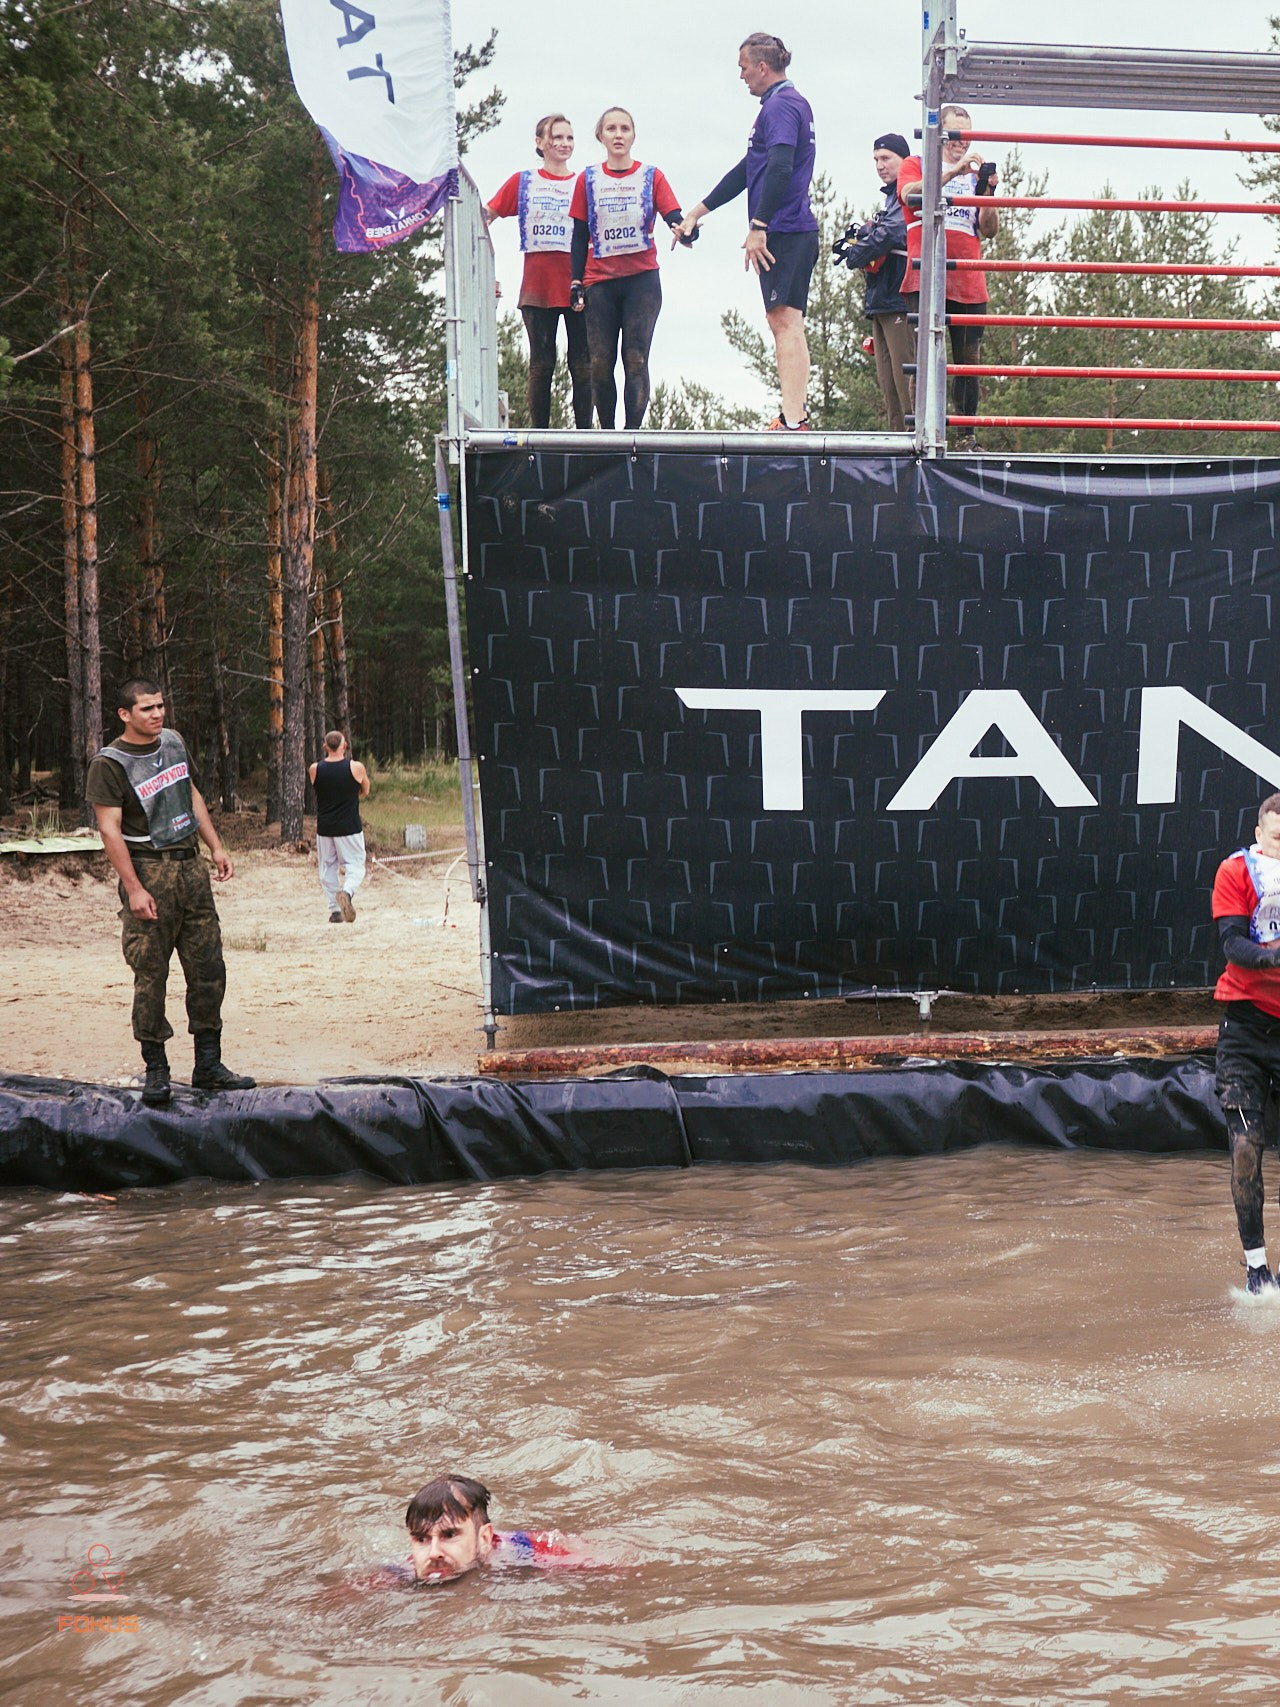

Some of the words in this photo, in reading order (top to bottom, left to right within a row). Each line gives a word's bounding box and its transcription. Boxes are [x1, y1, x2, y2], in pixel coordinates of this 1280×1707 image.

[943, 207, 970, 220] 3206
[532, 225, 566, 236] 03209
[604, 227, 636, 240] 03202
